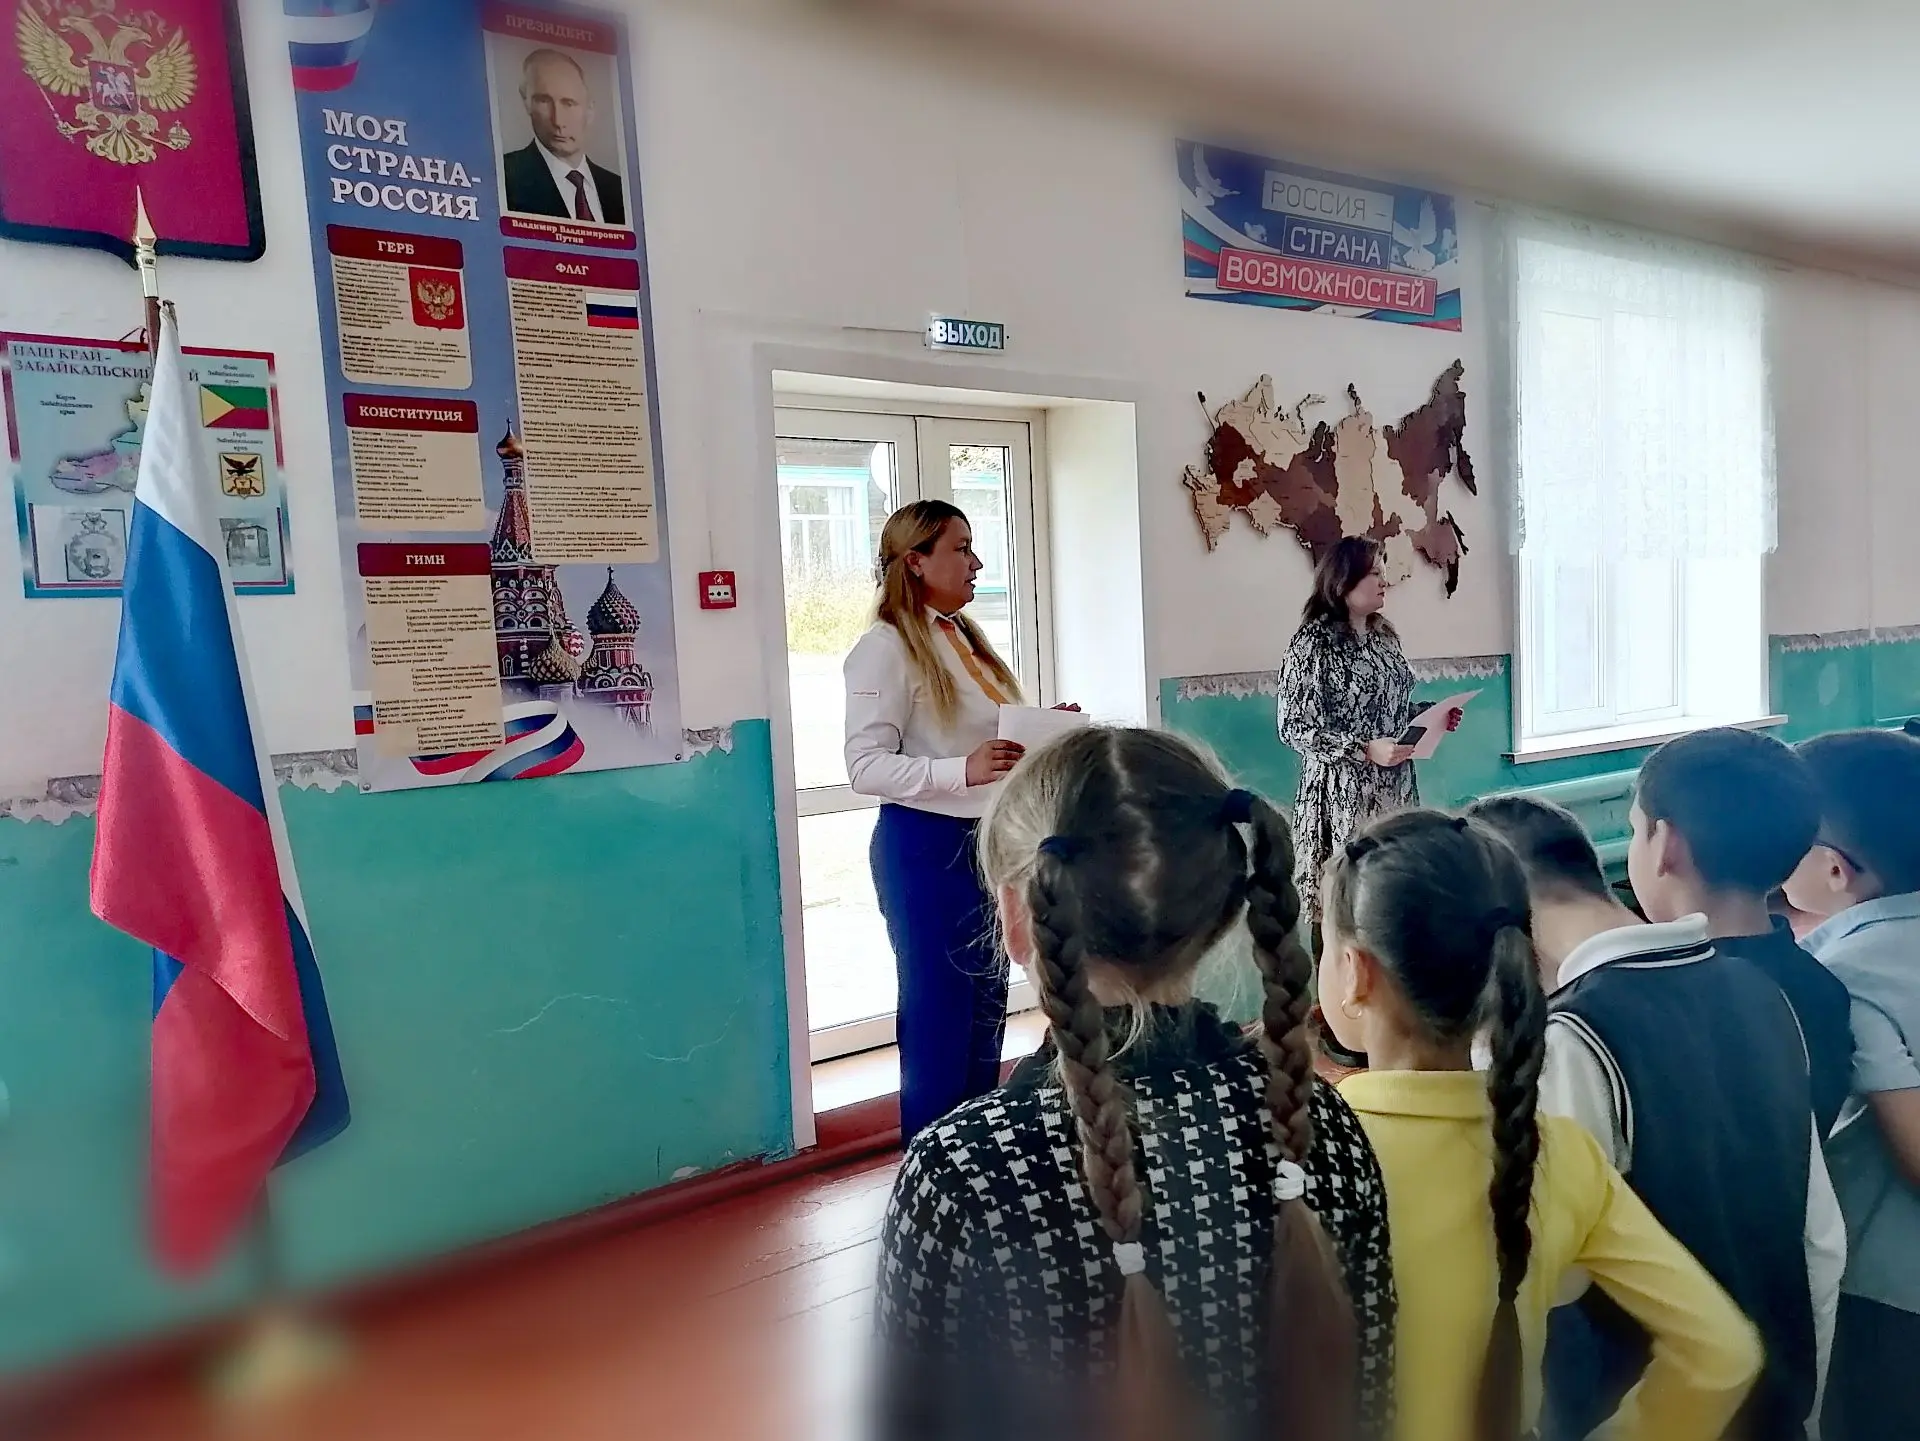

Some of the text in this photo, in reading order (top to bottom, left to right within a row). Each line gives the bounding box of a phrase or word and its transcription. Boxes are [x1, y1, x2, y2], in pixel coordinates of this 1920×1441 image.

[505, 14, 595, 42] ПРЕЗИДЕНТ
[322, 108, 409, 146] МОЯ
[327, 144, 482, 188] СТРАНА-
[330, 177, 480, 221] РОССИЯ
[1271, 180, 1366, 221] РОССИЯ
[511, 219, 625, 241] Владимир Владимирович
[555, 233, 584, 244] Путин
[377, 240, 415, 255] ГЕРБ
[1290, 226, 1382, 266] СТРАНА
[555, 262, 590, 276] ФЛАГ
[1226, 255, 1426, 309] ВОЗМОЖНОСТЕЙ
[933, 320, 1001, 349] ВЫХОД
[13, 345, 54, 358] НАШ
[59, 348, 102, 361] КРАЙ
[359, 405, 463, 422] КОНСТИТУЦИЯ
[405, 554, 446, 565] ГИМН
